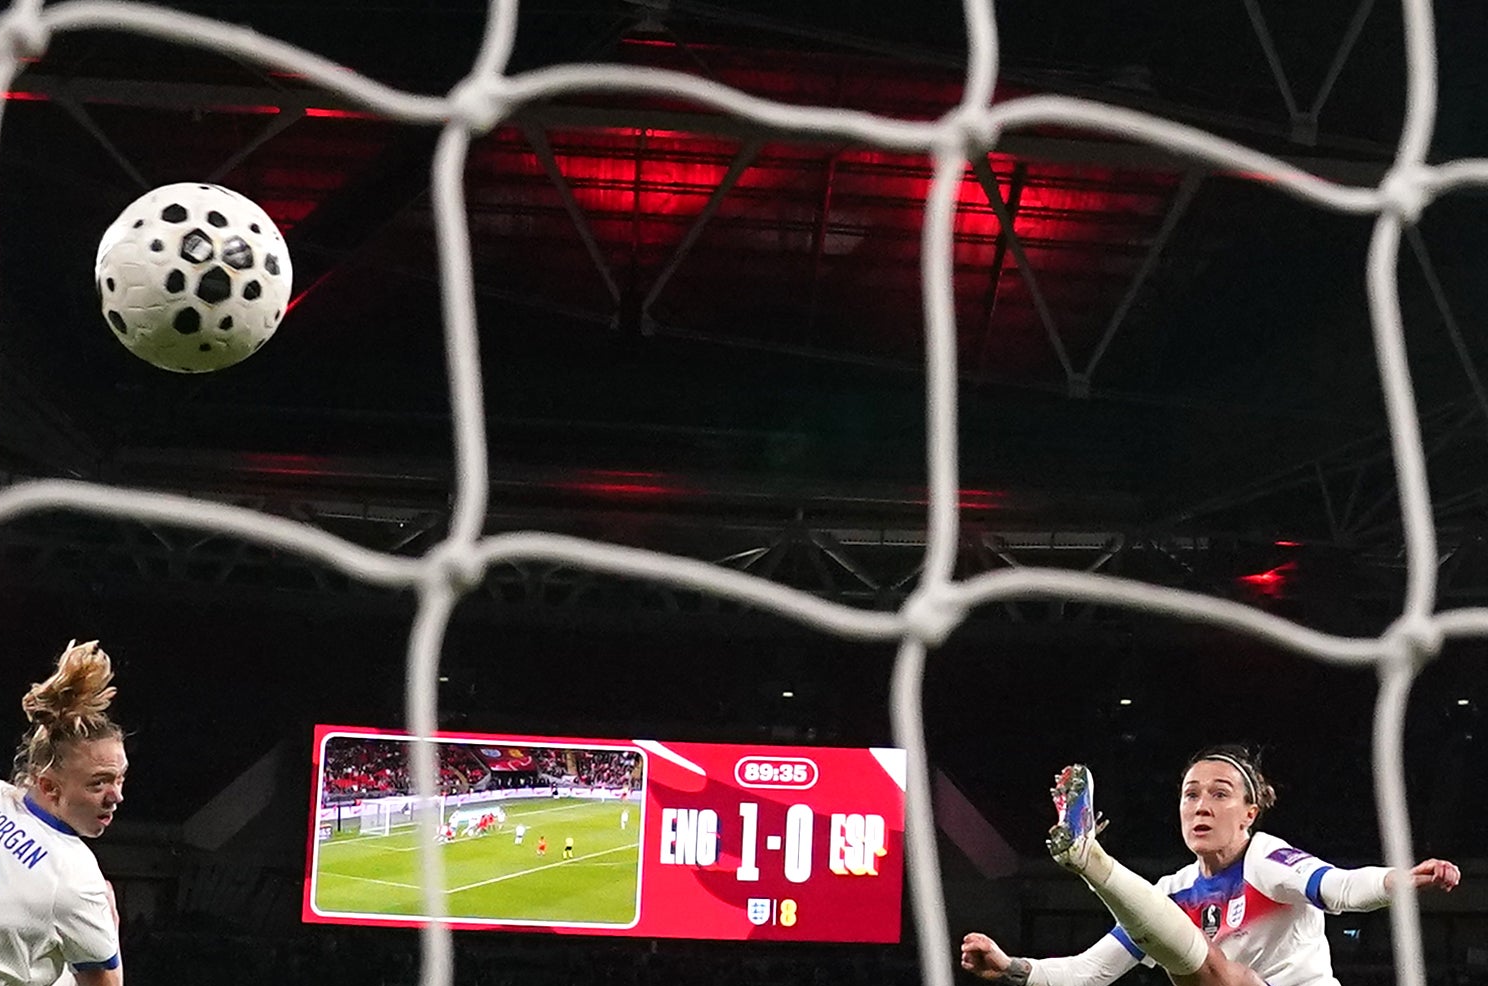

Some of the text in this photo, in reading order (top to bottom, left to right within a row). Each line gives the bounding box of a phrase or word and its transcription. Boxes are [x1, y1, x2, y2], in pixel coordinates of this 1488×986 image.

[744, 763, 808, 782] 89:35
[660, 807, 720, 867] ENG
[829, 813, 888, 876] ESP
[780, 898, 798, 927] 8
